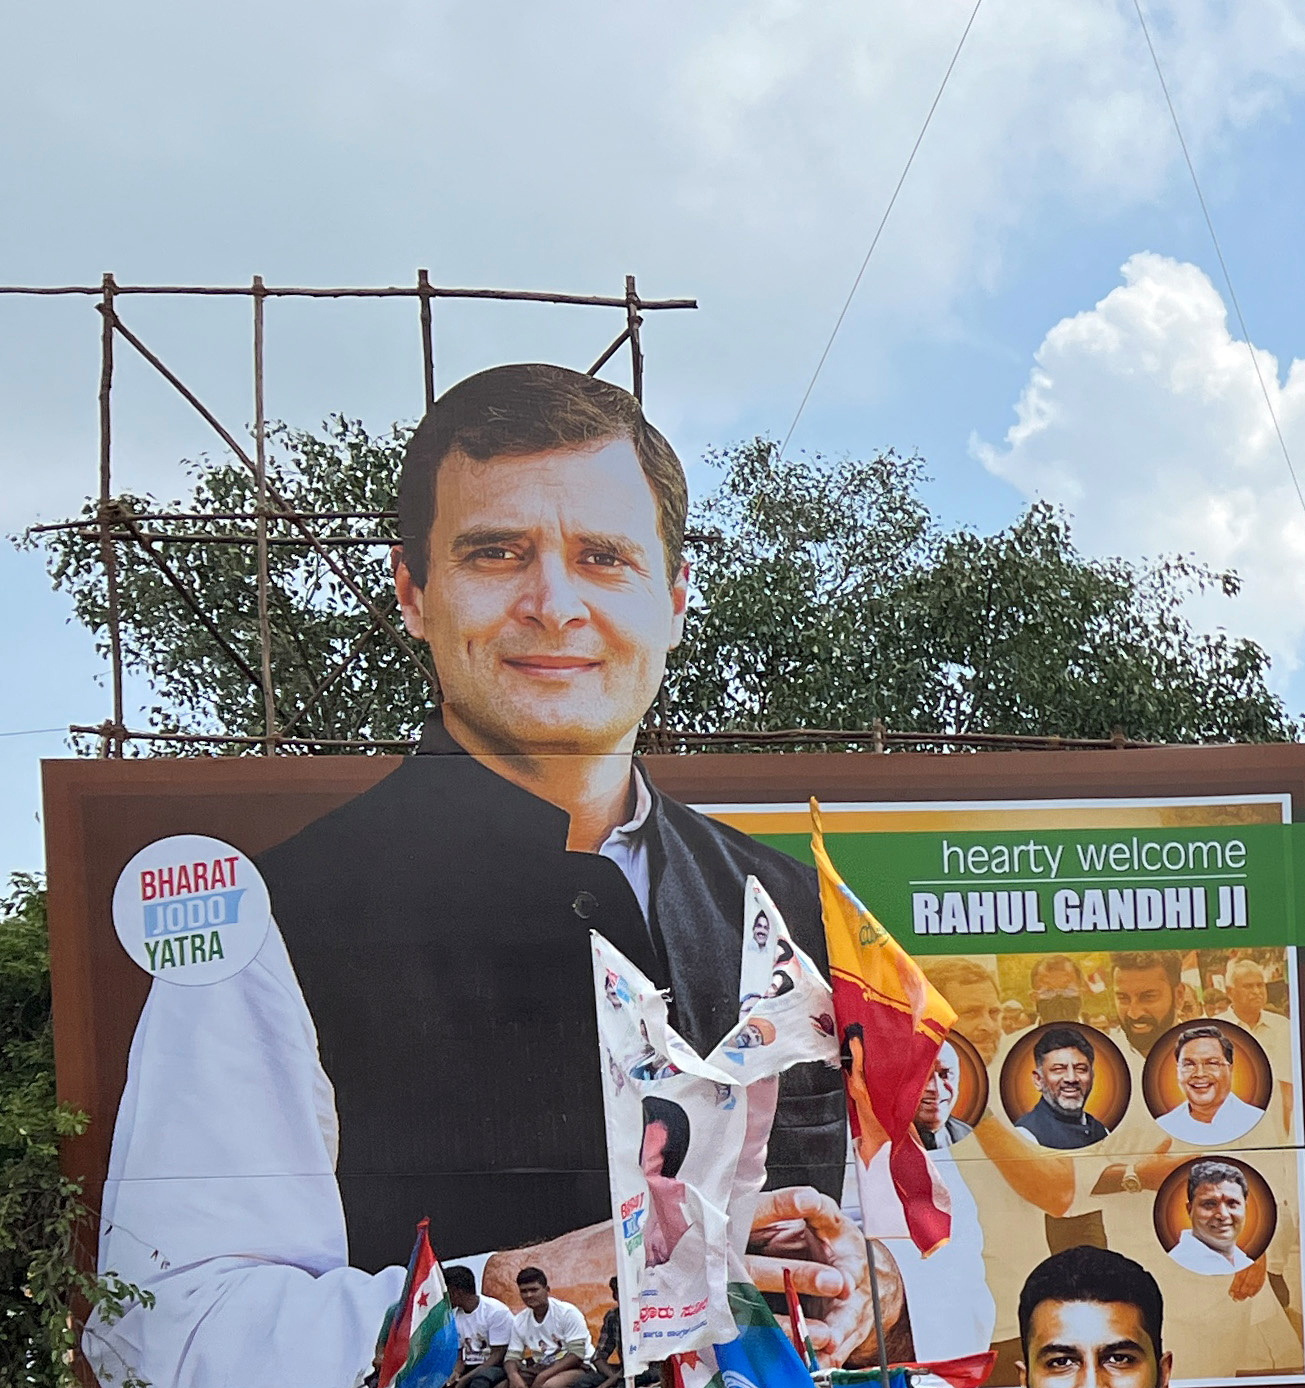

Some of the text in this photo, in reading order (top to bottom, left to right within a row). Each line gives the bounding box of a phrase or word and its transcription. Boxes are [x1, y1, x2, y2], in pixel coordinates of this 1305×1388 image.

[140, 856, 240, 901] BHARAT
[943, 837, 1247, 879] hearty welcome
[153, 895, 226, 935] JODO
[912, 889, 1046, 936] RAHUL
[1053, 887, 1207, 933] GANDHI
[1215, 885, 1249, 929] JI
[144, 931, 225, 971] YATRA
